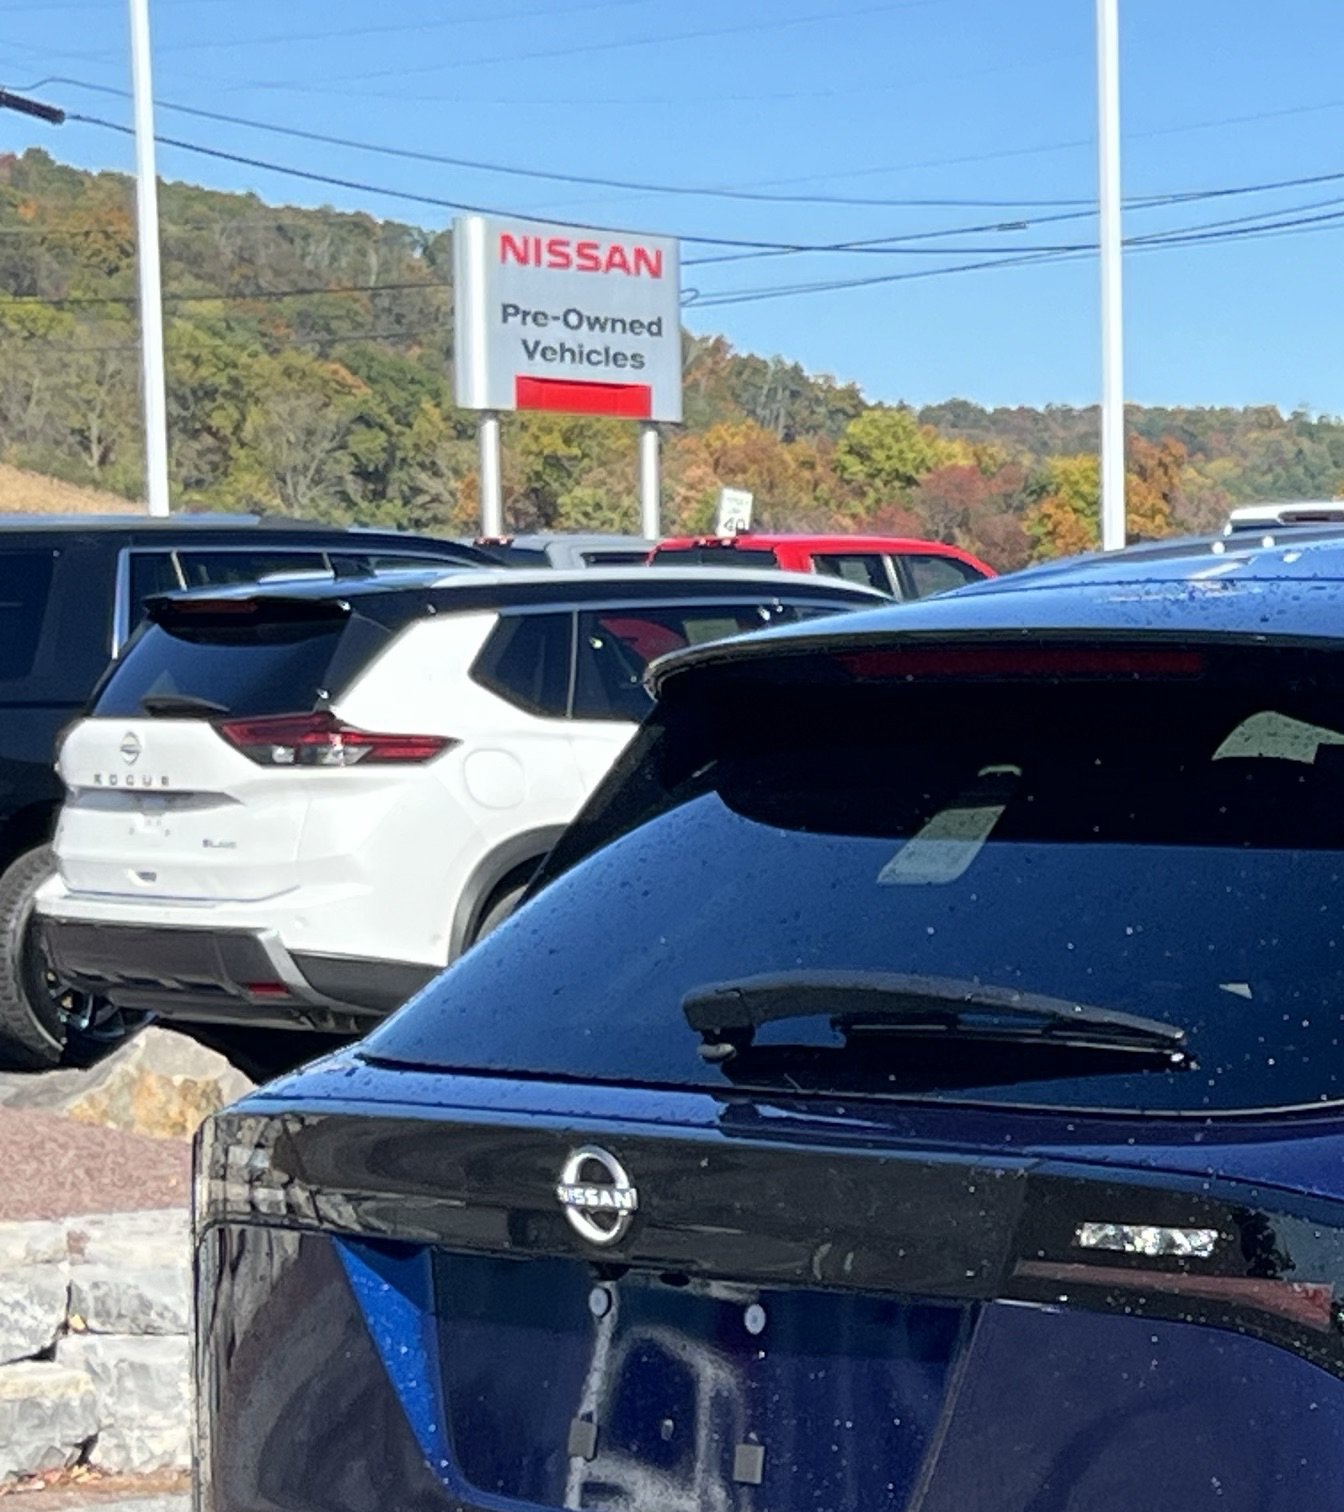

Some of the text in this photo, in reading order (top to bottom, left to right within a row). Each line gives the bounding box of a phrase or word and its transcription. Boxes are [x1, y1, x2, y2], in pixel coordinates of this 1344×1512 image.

[499, 234, 663, 279] NISSAN
[501, 303, 663, 338] Pre-Owned
[521, 339, 646, 370] Vehicles
[93, 774, 170, 787] ROGUE
[556, 1186, 633, 1209] NISSAN
